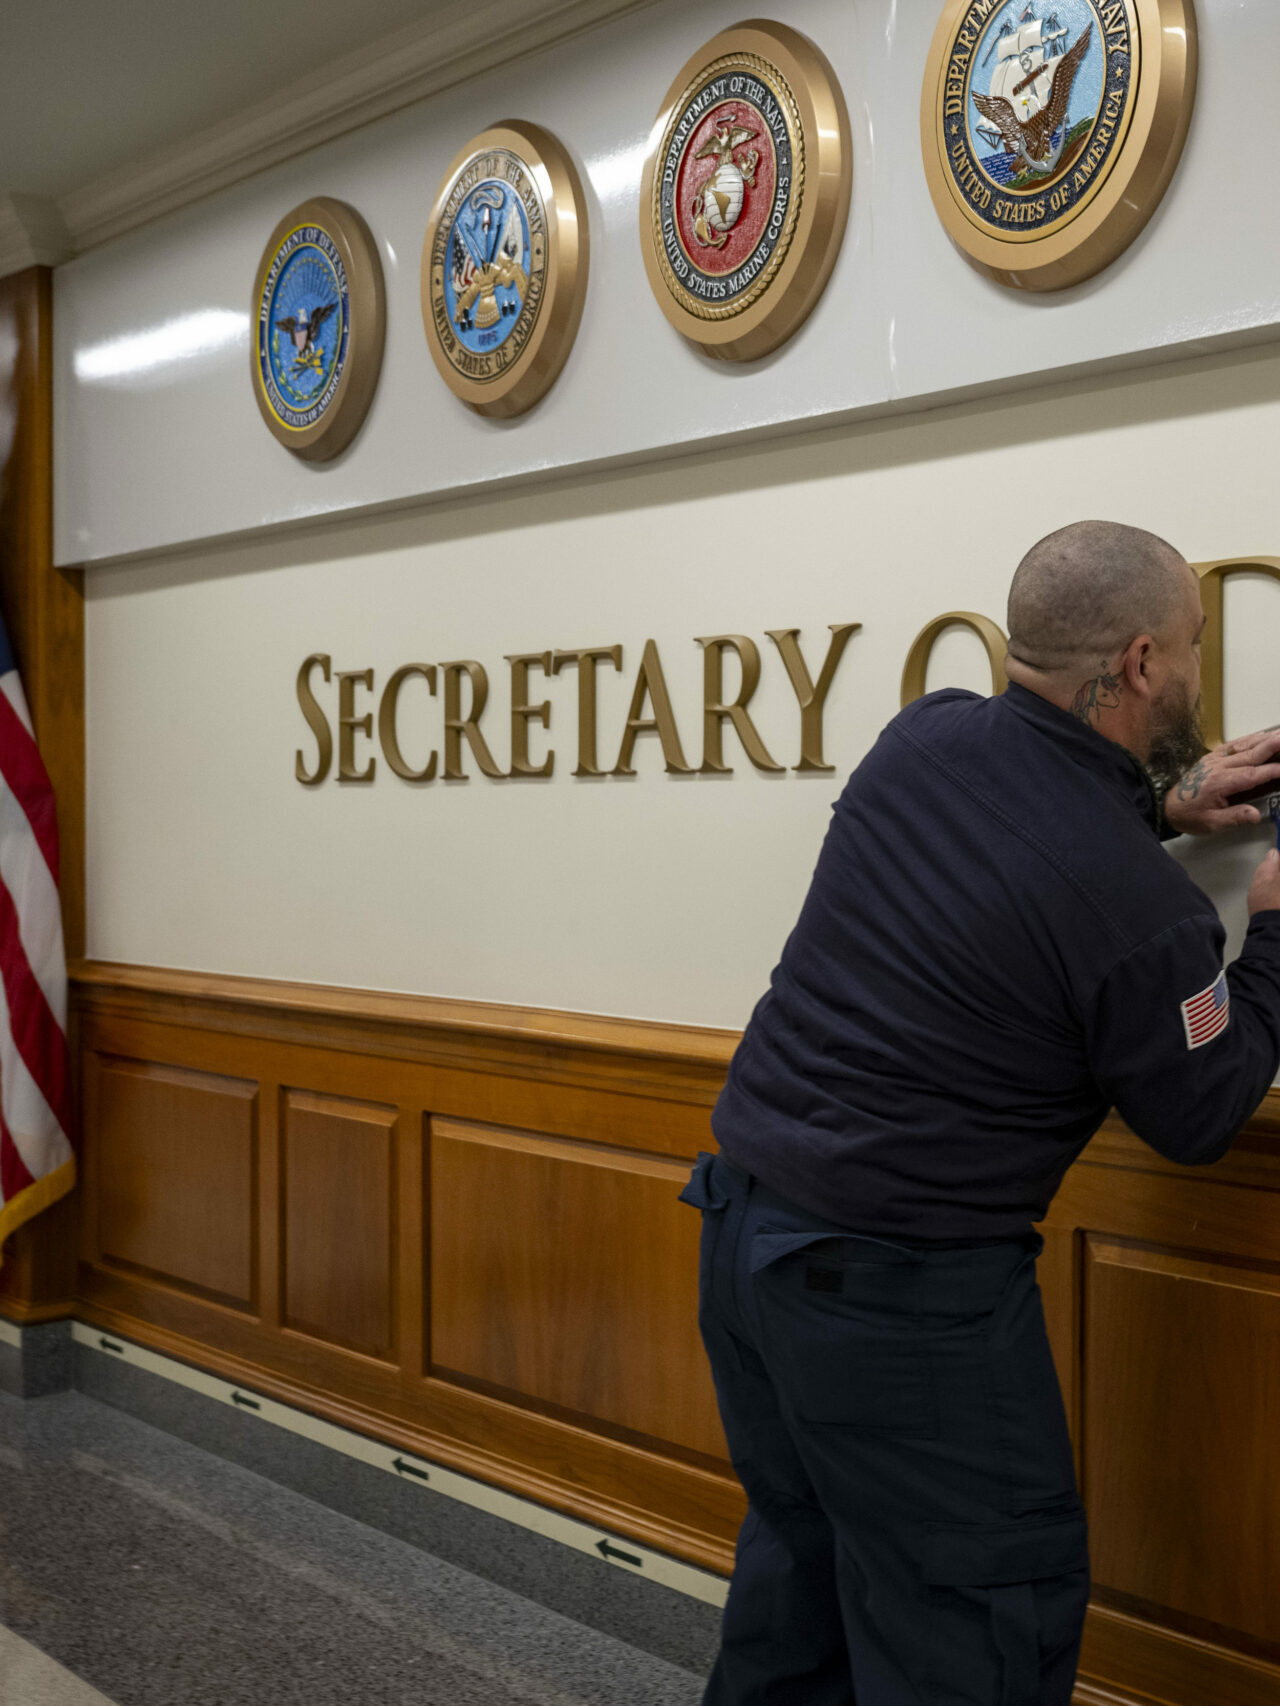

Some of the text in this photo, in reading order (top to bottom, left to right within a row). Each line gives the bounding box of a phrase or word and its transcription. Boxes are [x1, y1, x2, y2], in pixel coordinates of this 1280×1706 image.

[945, 0, 1128, 117] DEPARTM AVY
[664, 77, 787, 184] DEPARTMENT OF THE NAVY
[951, 89, 1124, 223] UNITED STATES OF AMERICA
[505, 160, 524, 188] THE
[523, 186, 545, 235] ARMY
[663, 176, 789, 298] UNITED STATES MARINE CORPS
[306, 227, 319, 242] OF
[319, 231, 348, 299] DEFENSE
[434, 269, 544, 375] UNITED STATES OF AMERICA
[295, 622, 863, 785] SECRETARY
